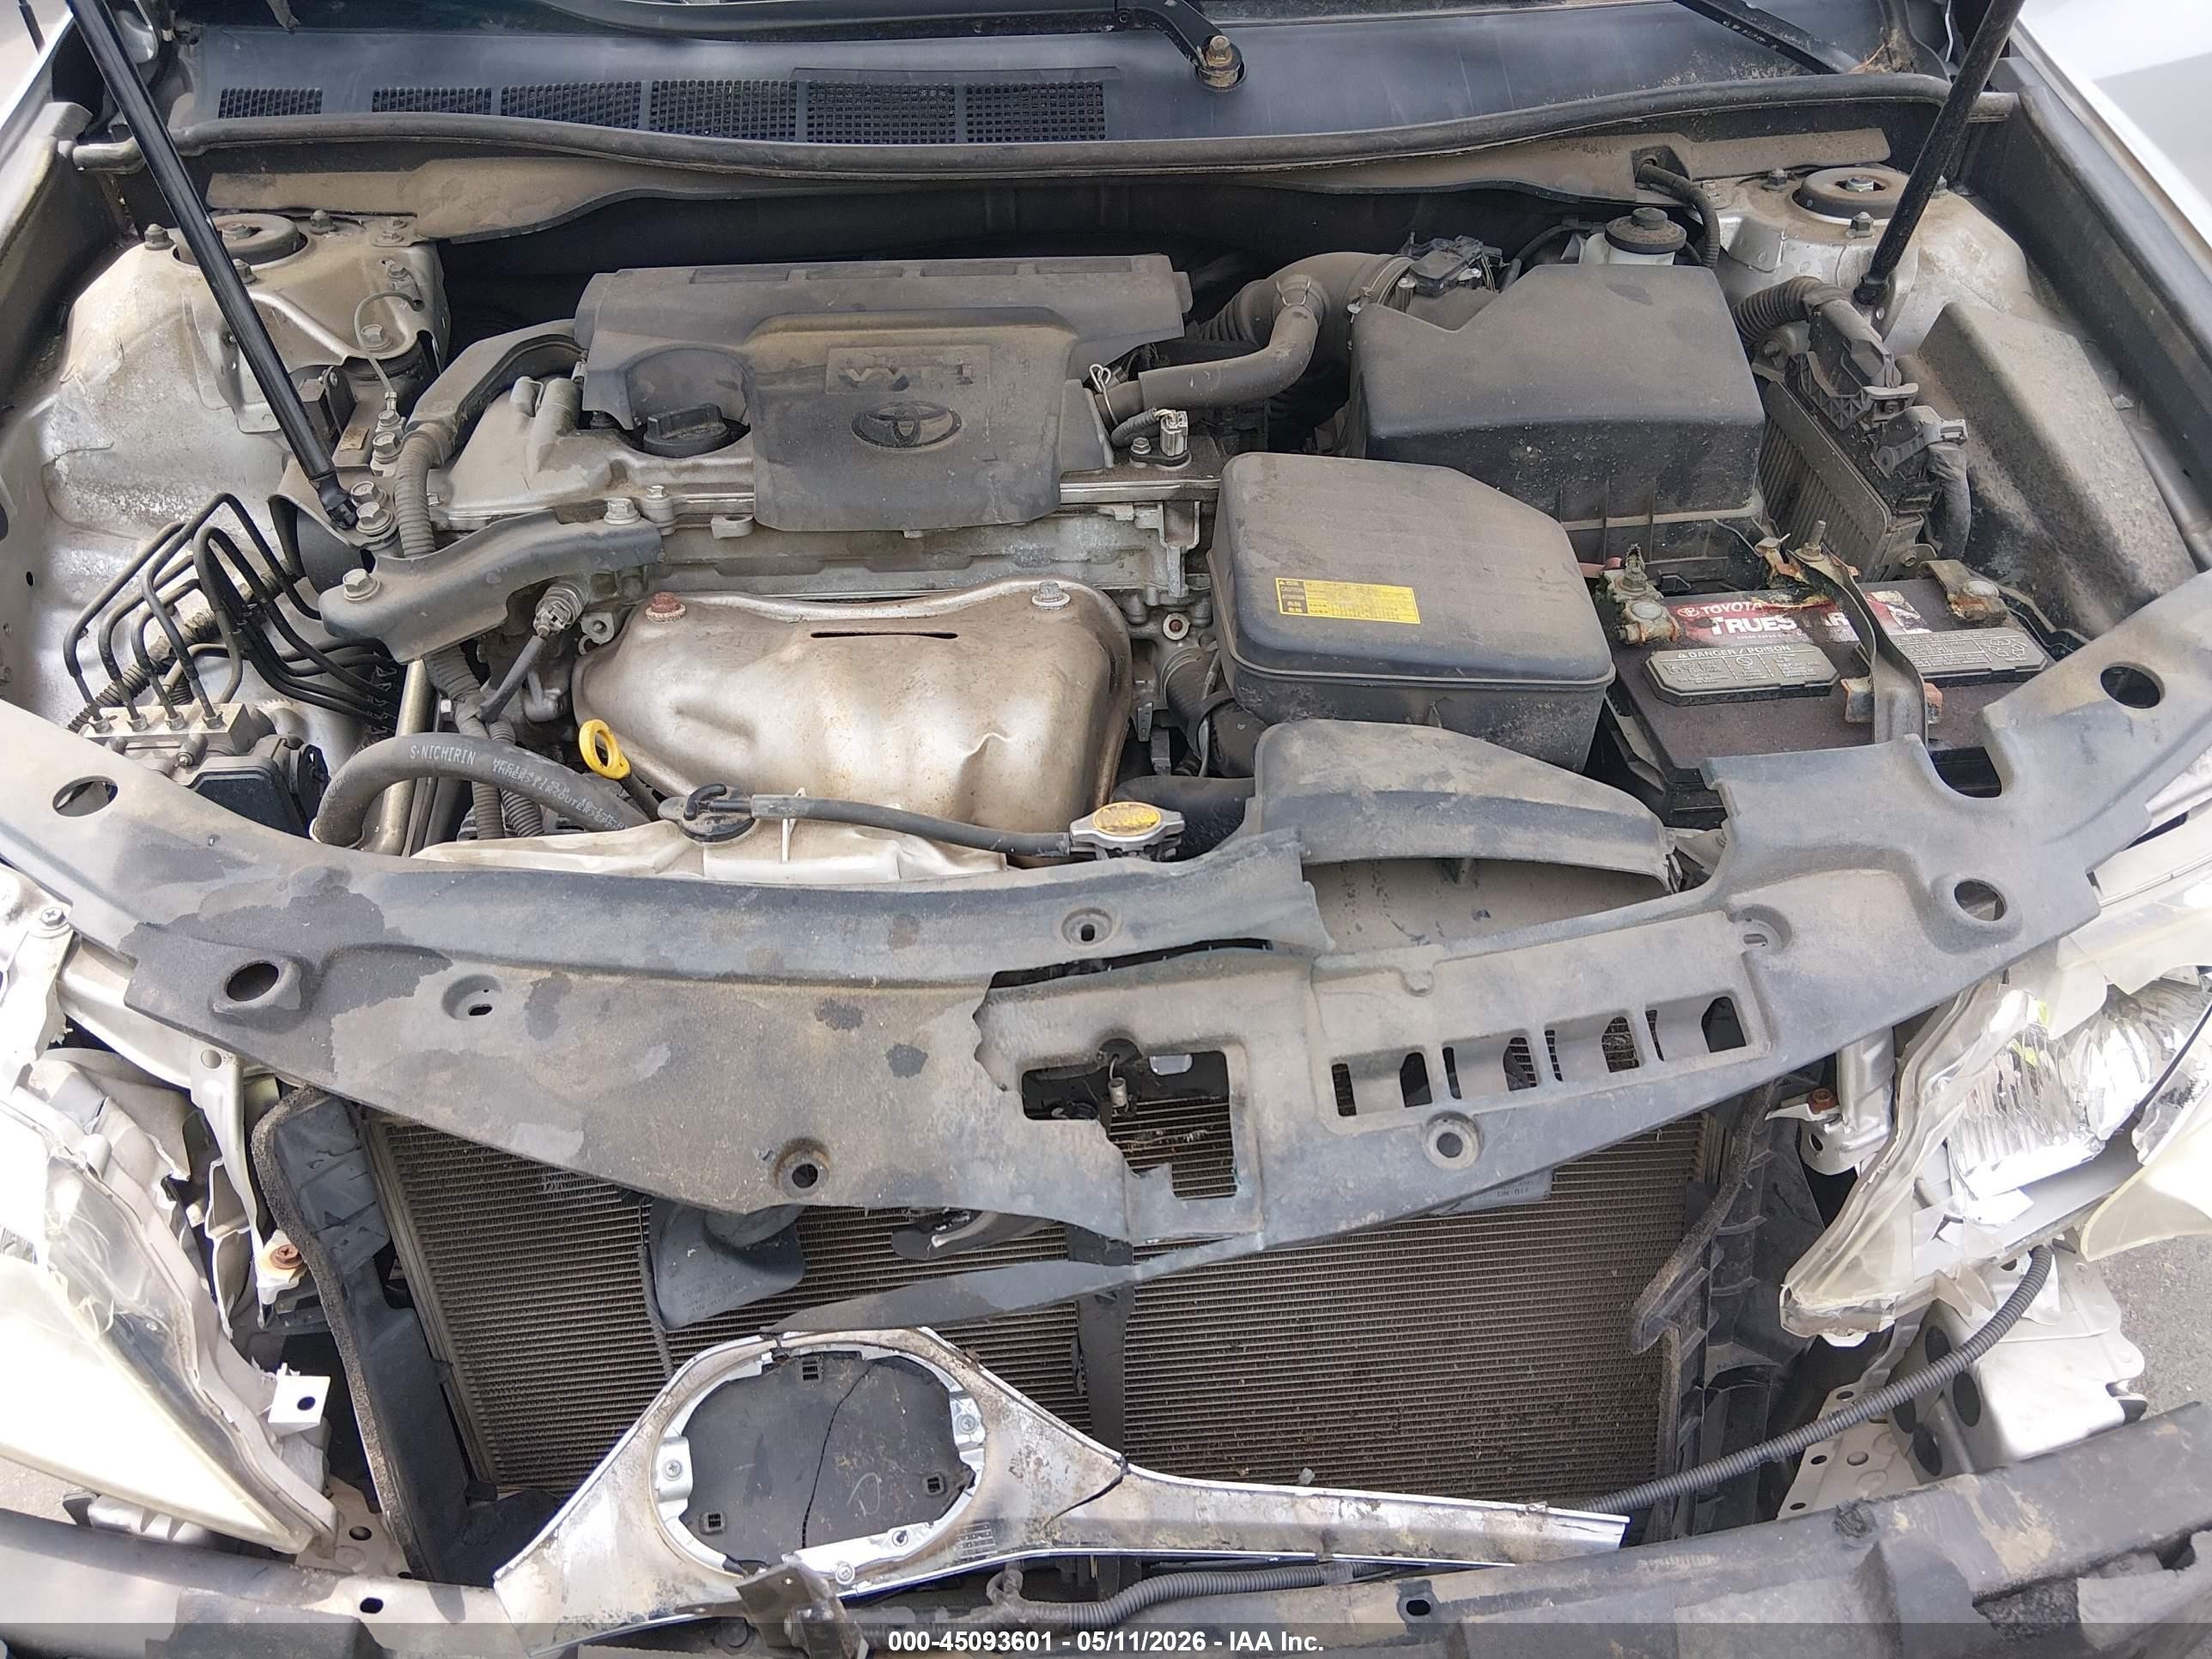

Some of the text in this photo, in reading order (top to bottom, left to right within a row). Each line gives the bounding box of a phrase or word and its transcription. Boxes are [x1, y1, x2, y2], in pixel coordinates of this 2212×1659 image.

[1700, 601, 1763, 616] TOYOTA
[1687, 647, 1736, 659] DANGER
[1747, 645, 1791, 654] POISON
